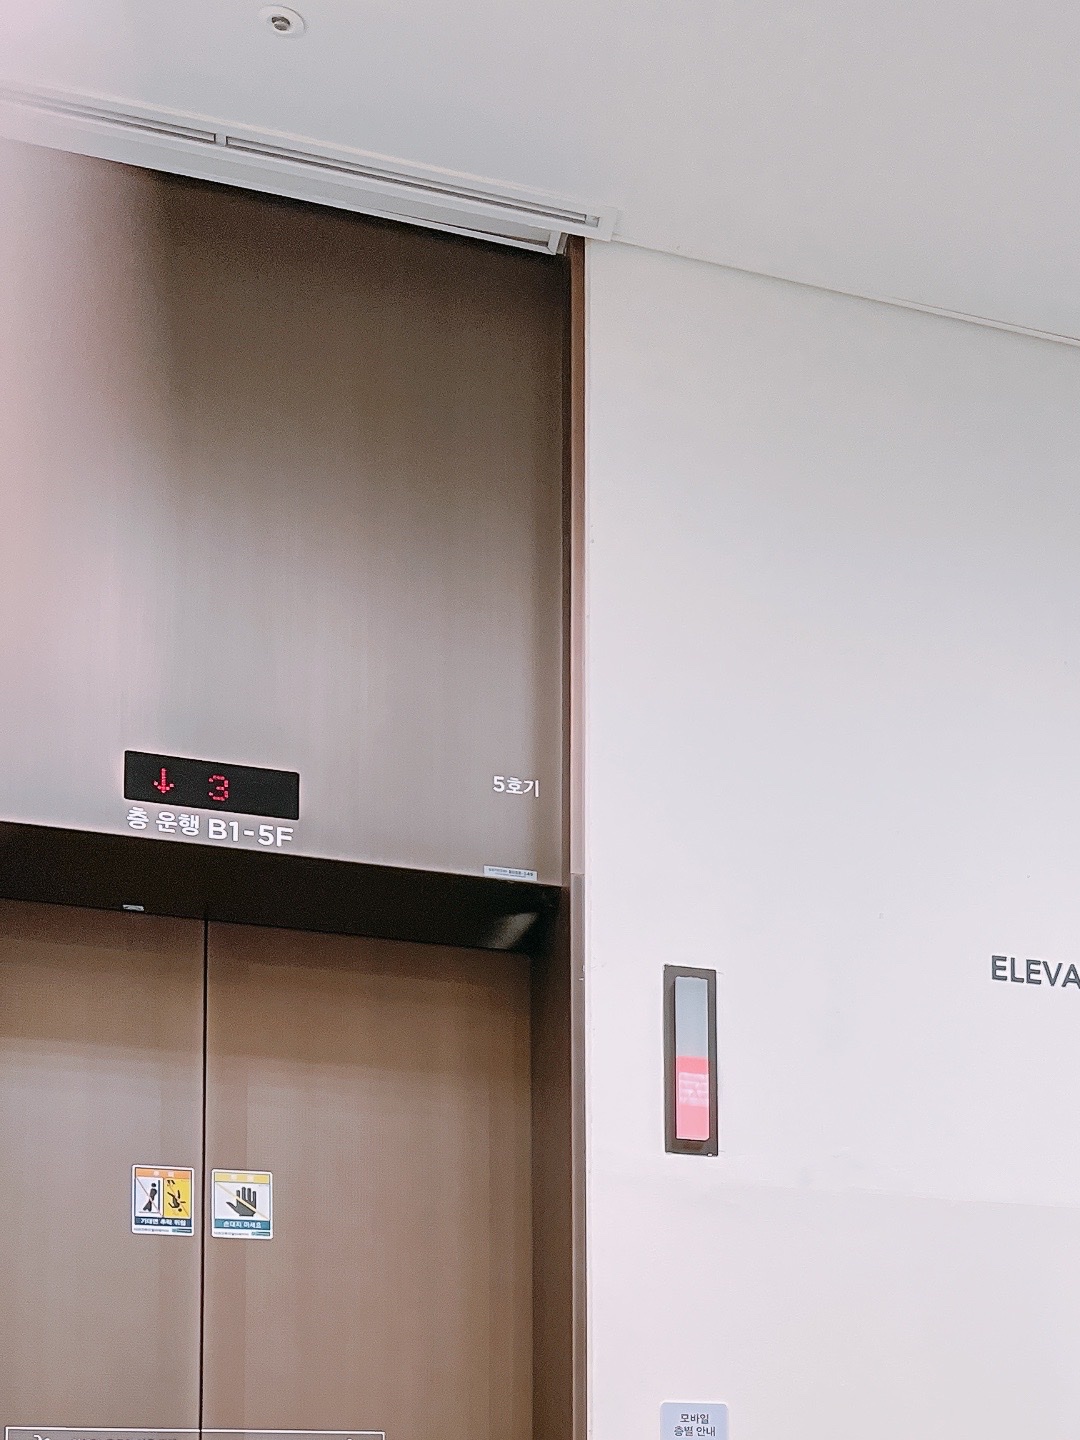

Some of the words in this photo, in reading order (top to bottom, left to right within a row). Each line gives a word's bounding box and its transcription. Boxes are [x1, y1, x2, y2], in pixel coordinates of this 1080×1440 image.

[208, 774, 229, 802] 3
[492, 775, 540, 798] 5호기
[126, 806, 149, 830] 층
[155, 810, 200, 836] 운행
[208, 818, 294, 847] B1-5F
[680, 1413, 709, 1425] 모바일
[674, 1425, 694, 1437] 층별
[696, 1425, 716, 1437] 안내
